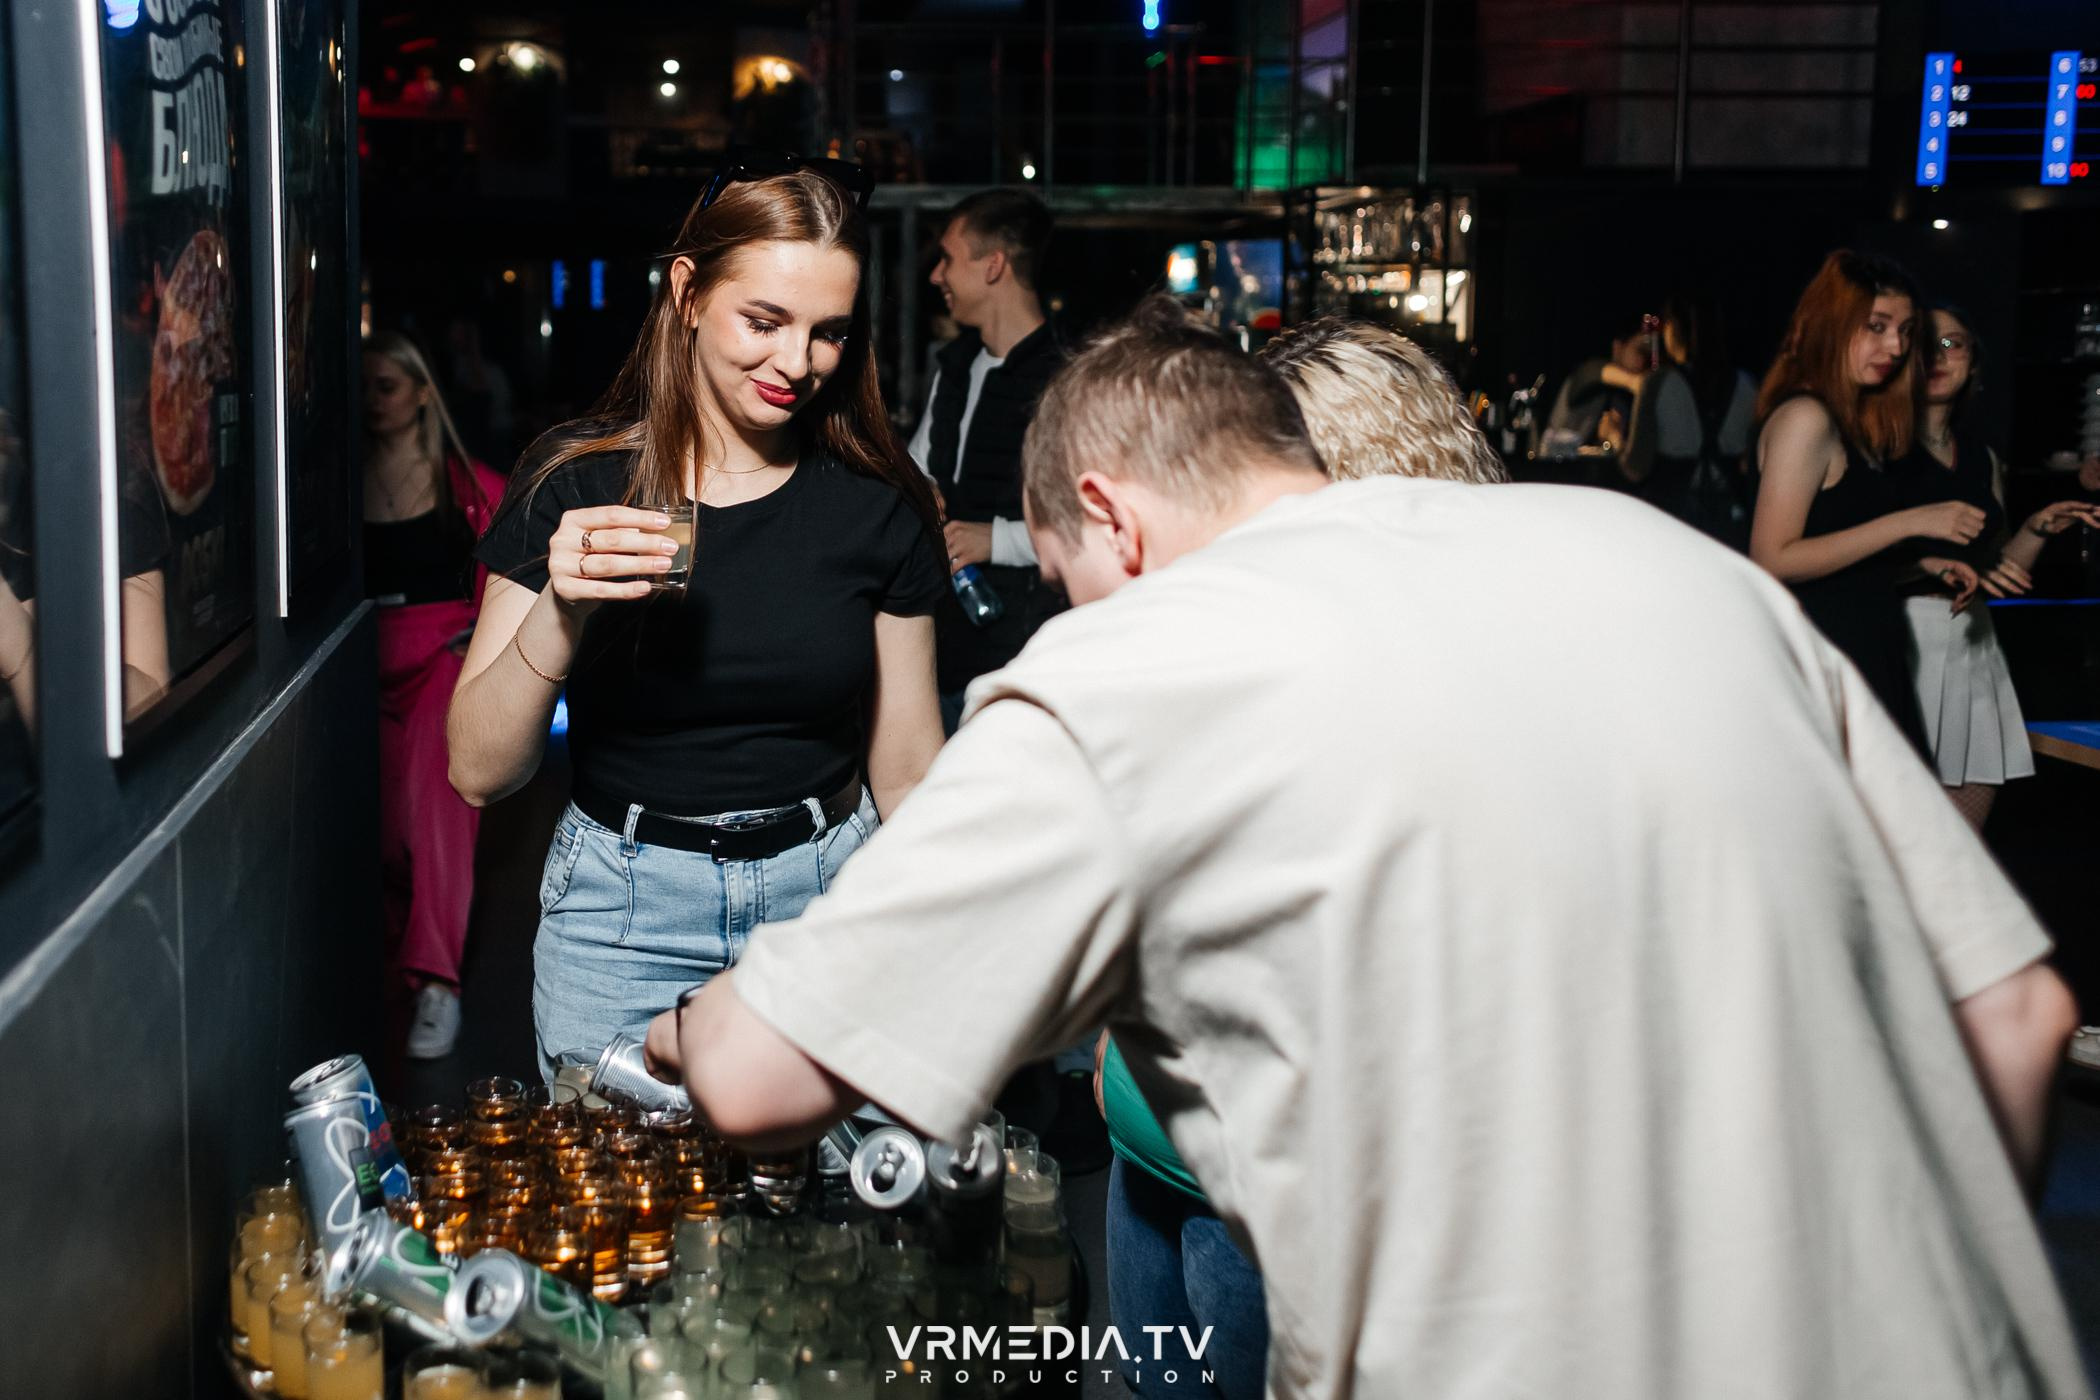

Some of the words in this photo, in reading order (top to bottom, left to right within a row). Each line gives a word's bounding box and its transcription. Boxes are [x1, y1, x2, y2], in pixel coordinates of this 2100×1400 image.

[1935, 59, 1945, 75] 1
[1931, 85, 1944, 101] 2
[1951, 84, 1971, 101] 12
[2056, 84, 2070, 99] 7
[1929, 111, 1942, 127] 3
[2053, 110, 2067, 126] 8
[1926, 137, 1939, 152] 4
[2051, 136, 2065, 152] 9
[1924, 162, 1938, 179] 5
[2047, 162, 2068, 178] 10
